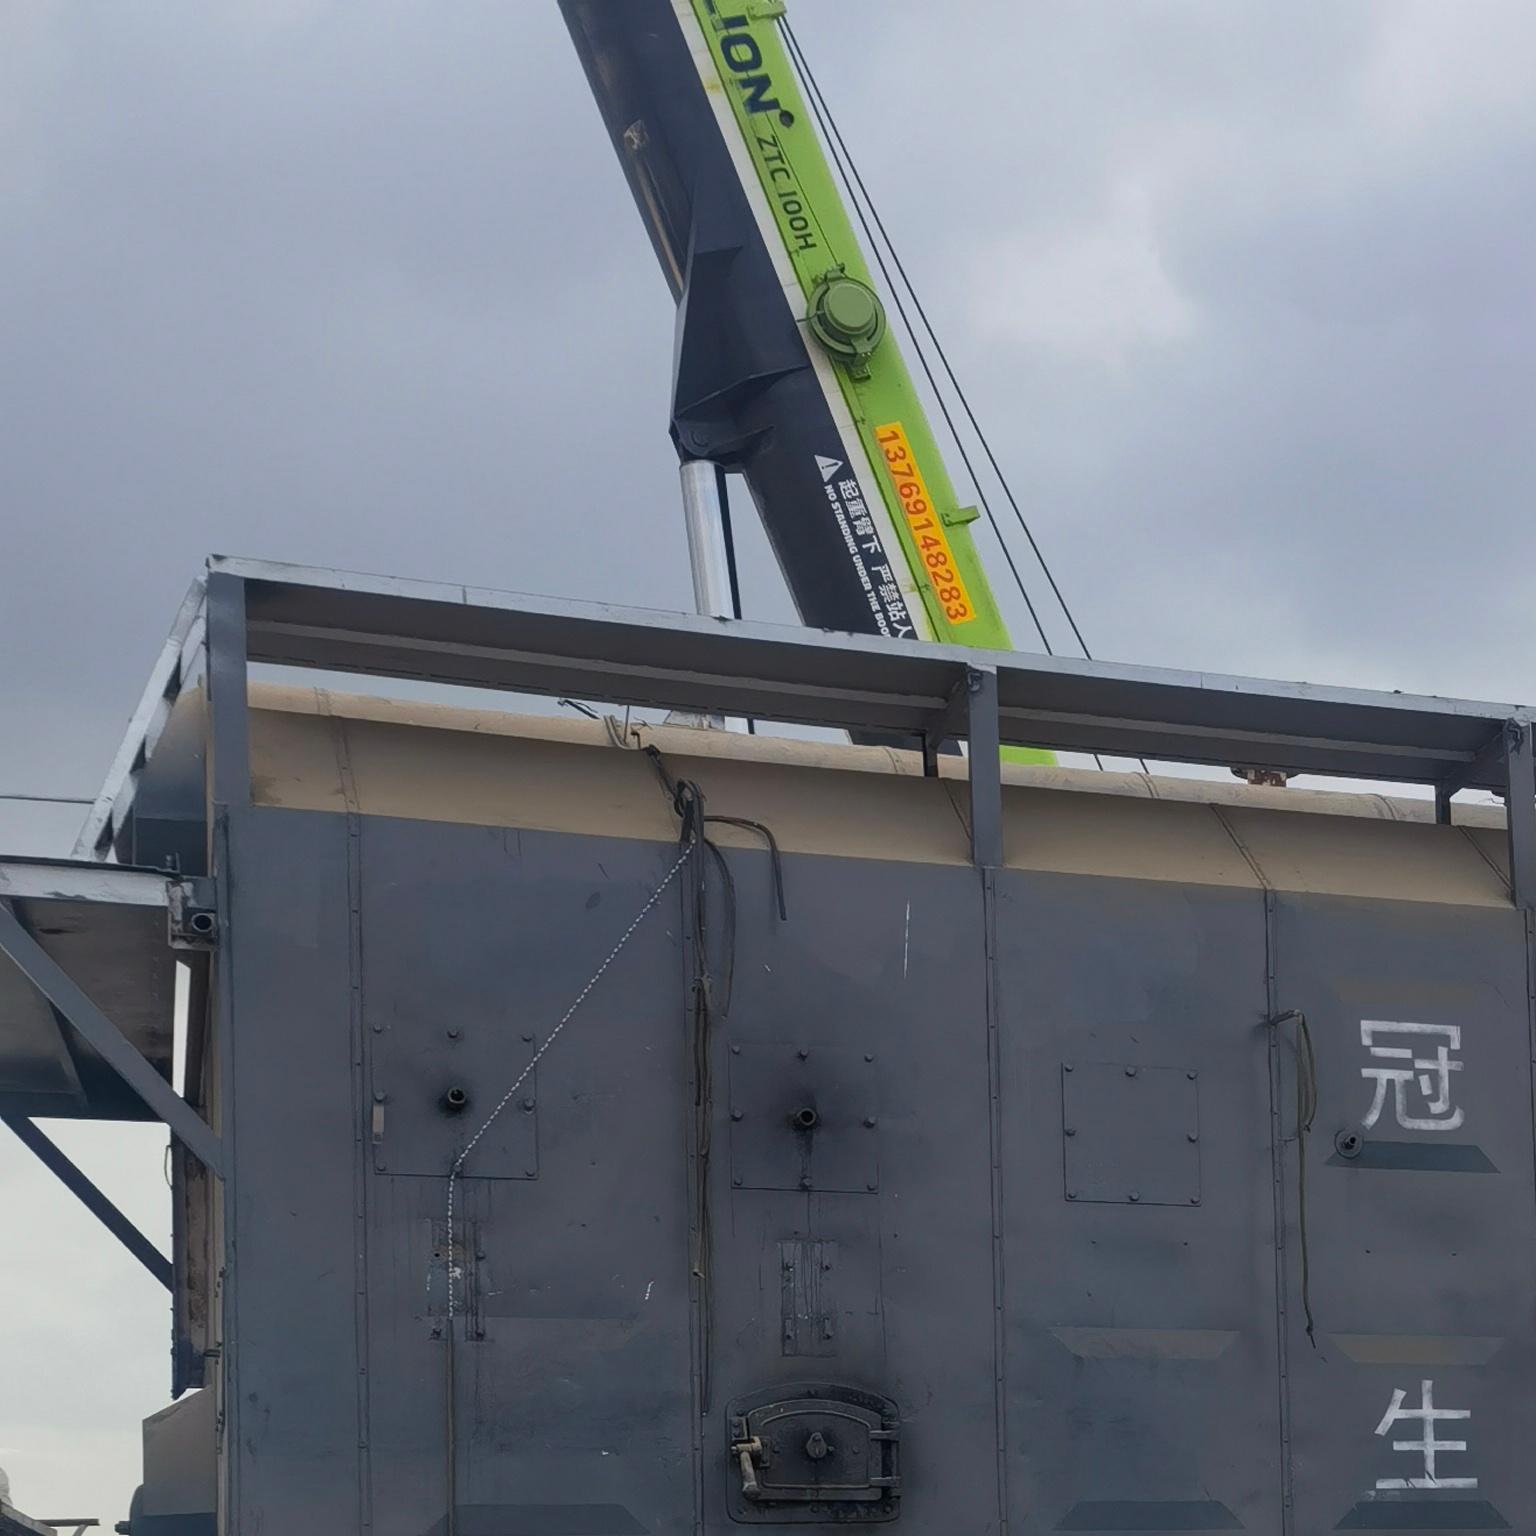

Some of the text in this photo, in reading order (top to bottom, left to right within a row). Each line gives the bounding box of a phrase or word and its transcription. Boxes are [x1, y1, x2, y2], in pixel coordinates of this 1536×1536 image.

[757, 134, 817, 251] ZTC 100H
[824, 484, 838, 502] NO
[831, 501, 859, 555] STANDING
[852, 554, 873, 591] UNDER
[866, 590, 881, 613] THE
[878, 430, 968, 621] 13769148283
